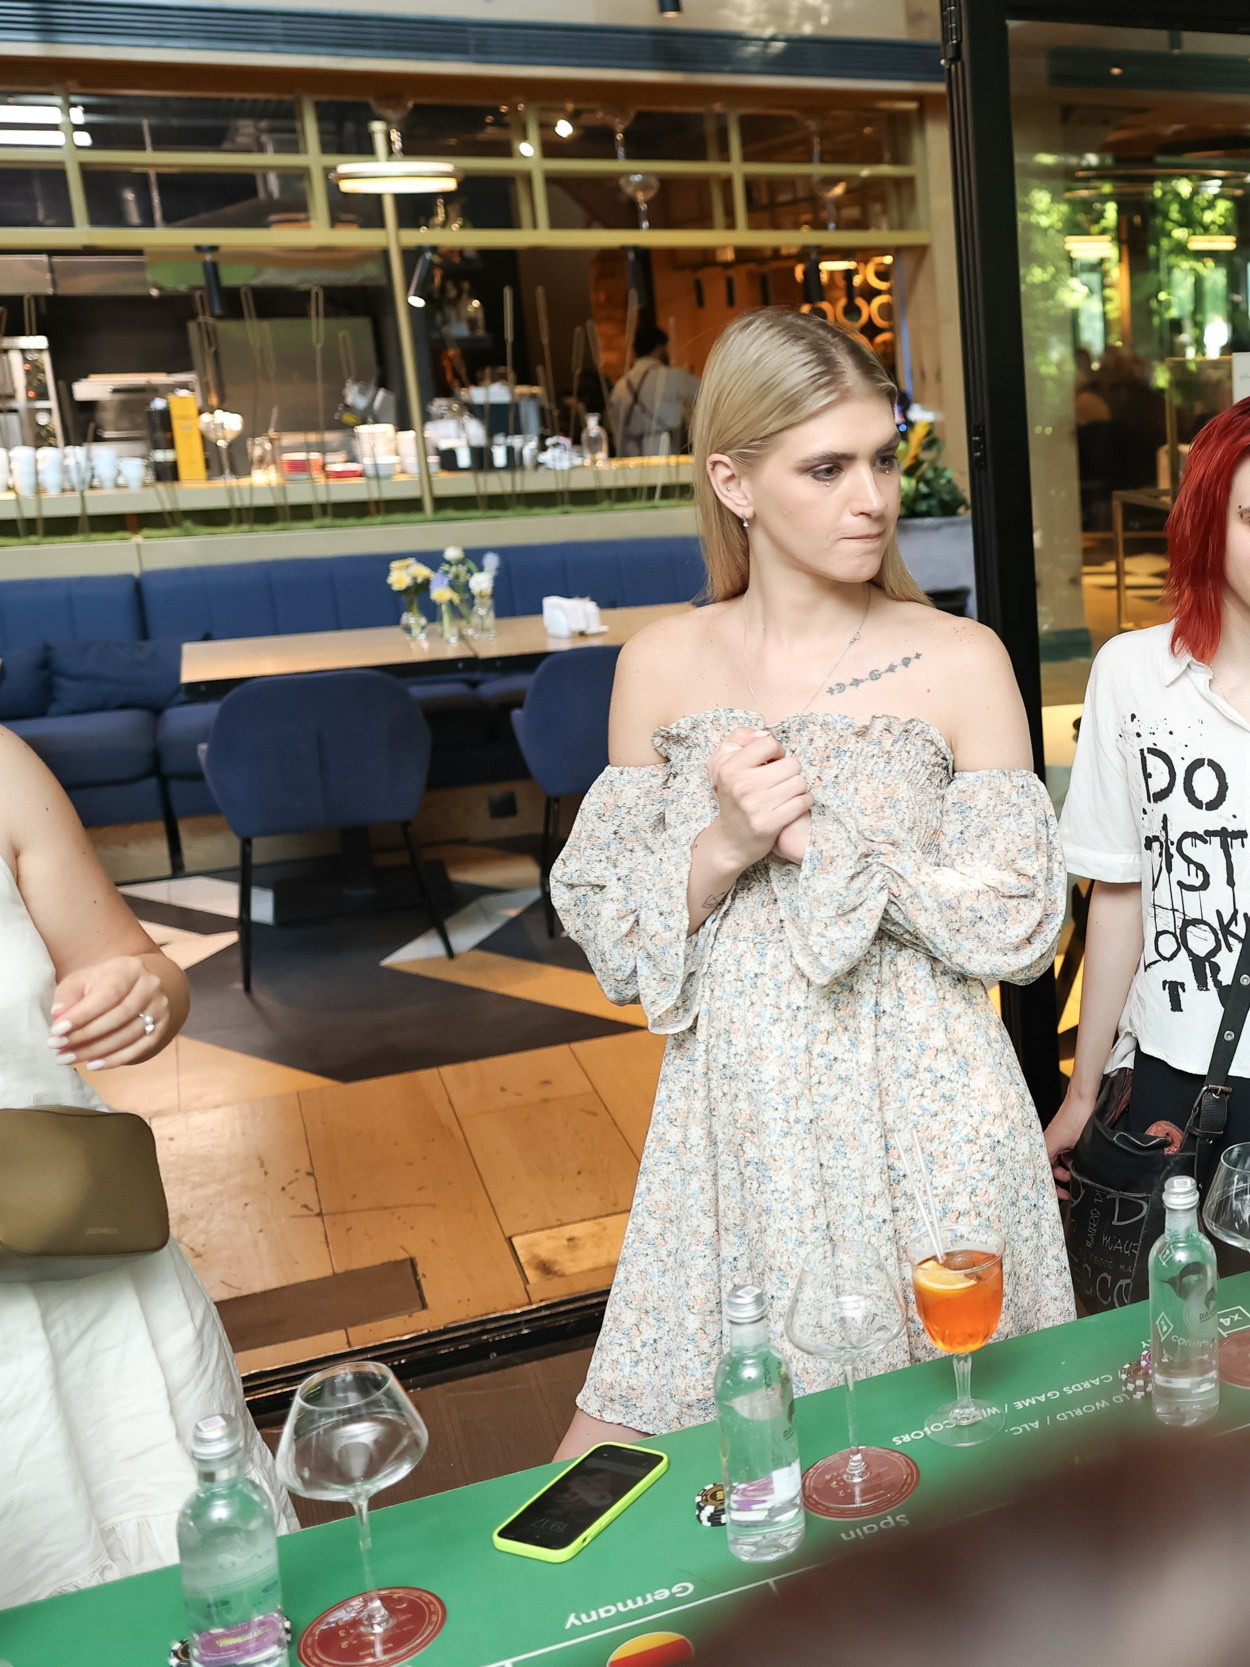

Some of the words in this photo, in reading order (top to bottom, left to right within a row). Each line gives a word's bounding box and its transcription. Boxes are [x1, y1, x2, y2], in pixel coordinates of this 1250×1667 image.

[1139, 747, 1229, 811] DO
[1063, 1374, 1113, 1395] CARDS
[1013, 1390, 1060, 1410] GAME
[1056, 1400, 1110, 1421] WORLD
[1112, 1393, 1132, 1405] LD
[891, 1419, 957, 1446] COLORS
[840, 1513, 910, 1541] Spain
[565, 1582, 694, 1629] Germany
